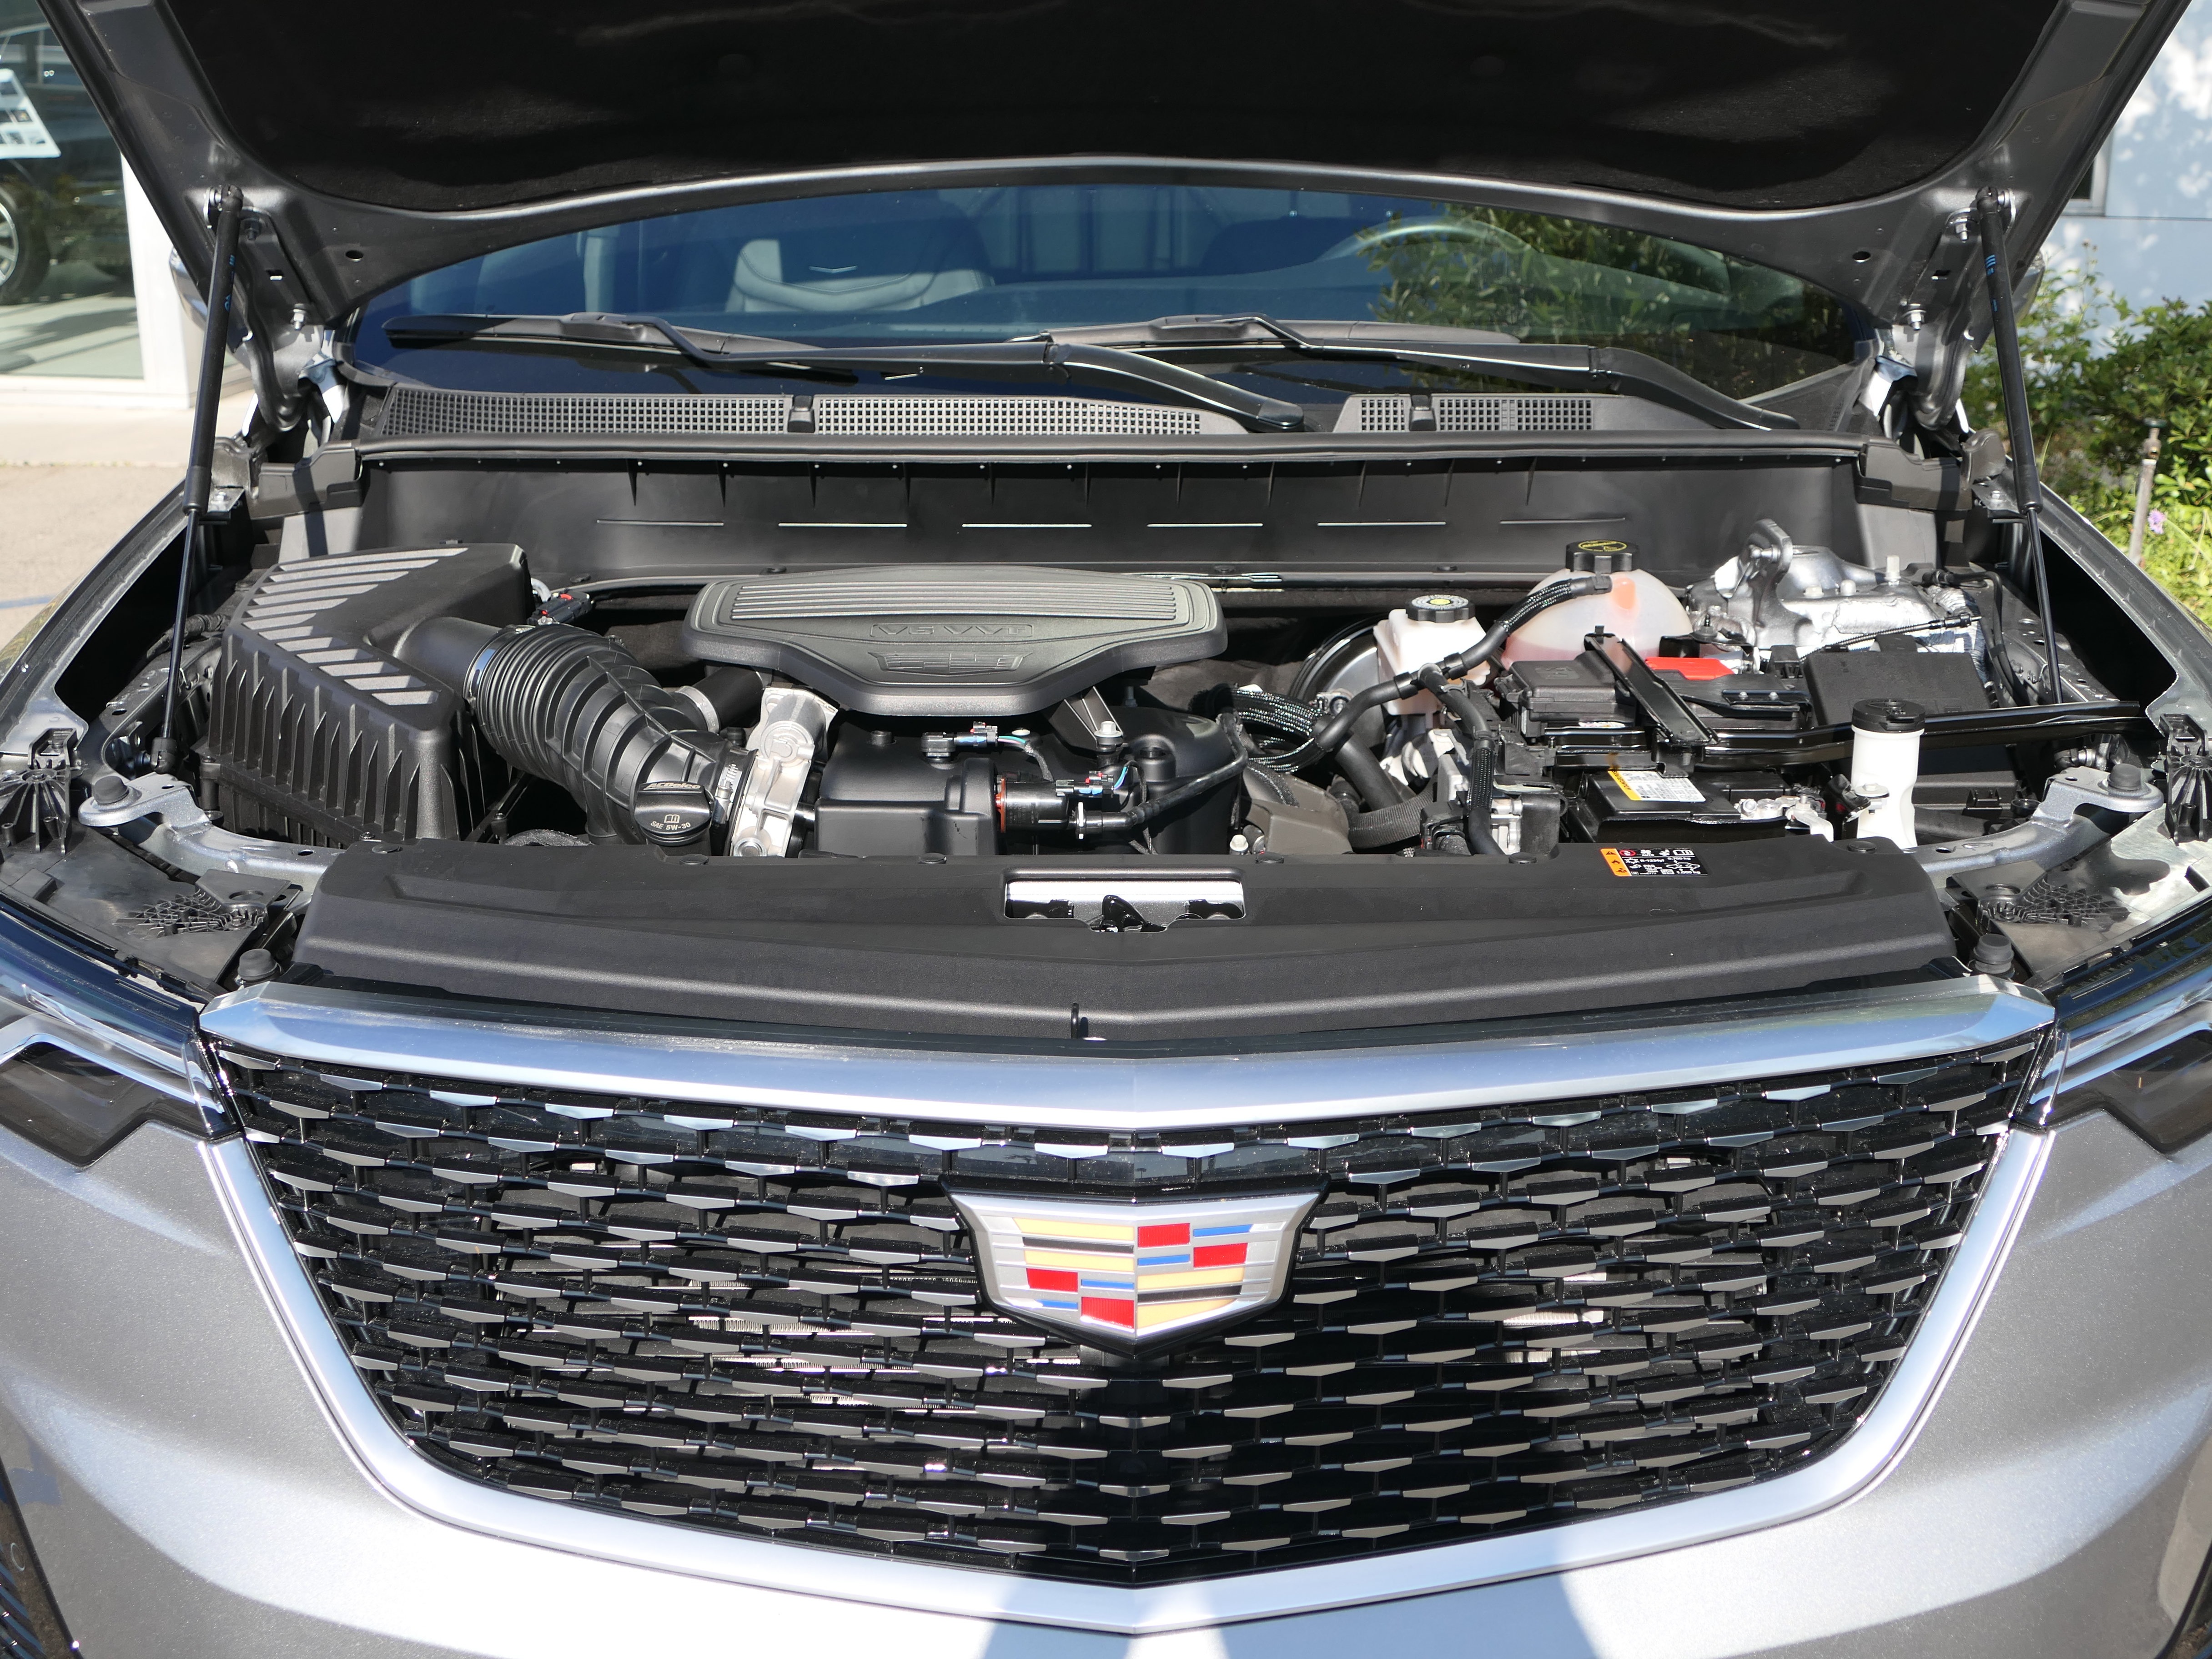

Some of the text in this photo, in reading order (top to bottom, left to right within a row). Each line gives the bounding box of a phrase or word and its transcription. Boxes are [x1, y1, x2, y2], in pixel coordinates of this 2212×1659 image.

[879, 626, 1026, 634] V6 VVT
[650, 820, 691, 830] SAE 5W-30
